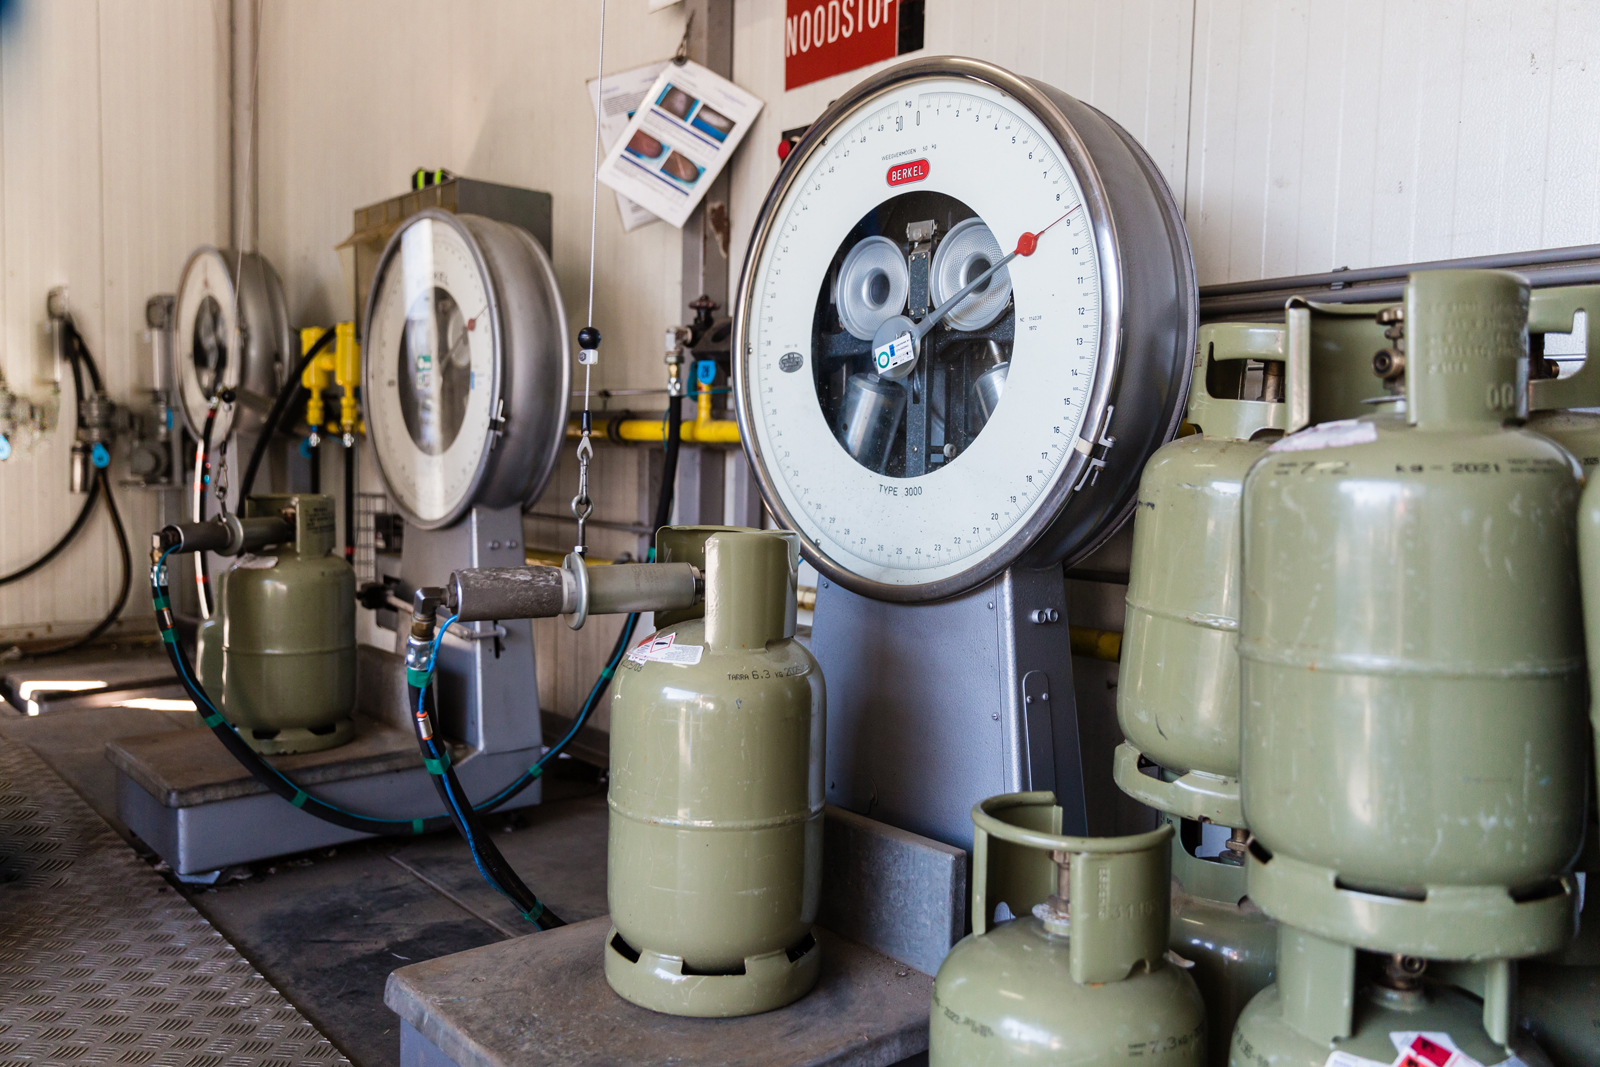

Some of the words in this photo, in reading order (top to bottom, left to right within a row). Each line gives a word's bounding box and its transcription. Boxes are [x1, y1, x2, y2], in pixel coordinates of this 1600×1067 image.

[896, 116, 903, 132] 50
[916, 110, 920, 126] 0
[892, 165, 924, 182] BERKEL
[1450, 462, 1500, 474] 2021
[879, 484, 898, 496] TYPE
[904, 486, 922, 497] 3000
[751, 670, 770, 679] 6.3
